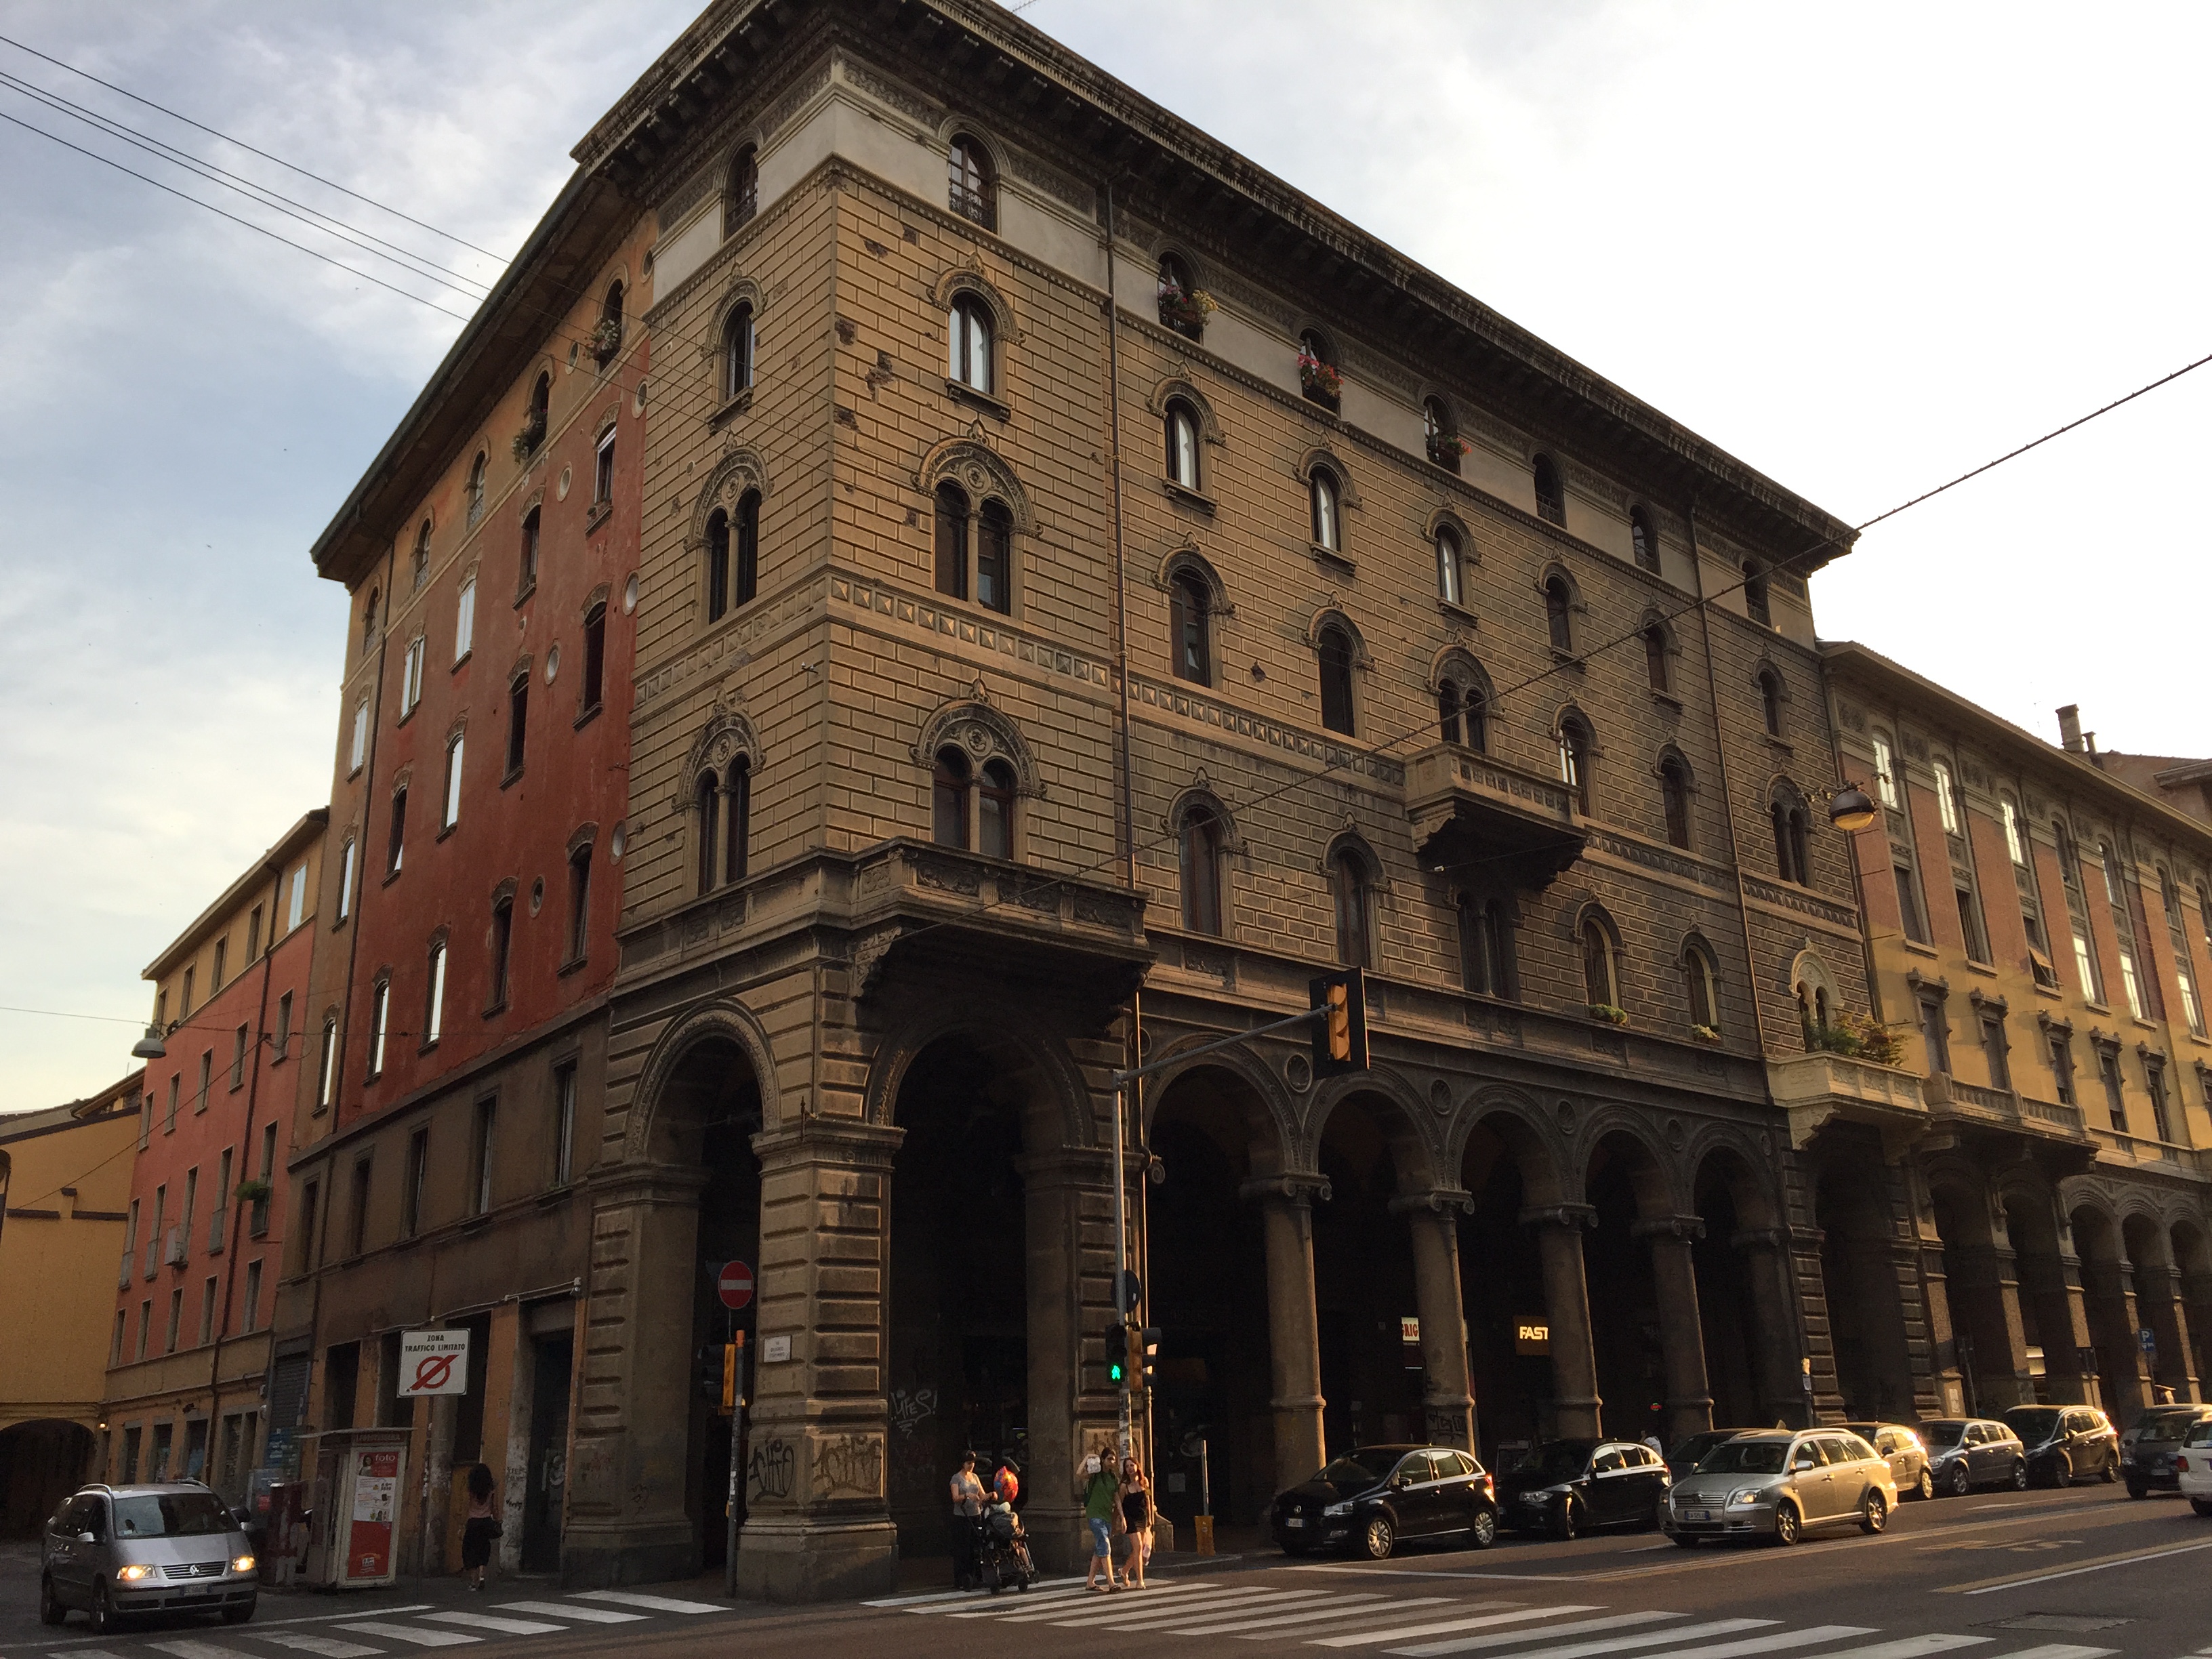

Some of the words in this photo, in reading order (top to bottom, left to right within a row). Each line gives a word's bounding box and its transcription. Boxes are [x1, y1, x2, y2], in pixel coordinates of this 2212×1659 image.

[1519, 1326, 1549, 1340] FAST
[2142, 1330, 2150, 1342] P
[438, 1343, 465, 1351] LIMITATO
